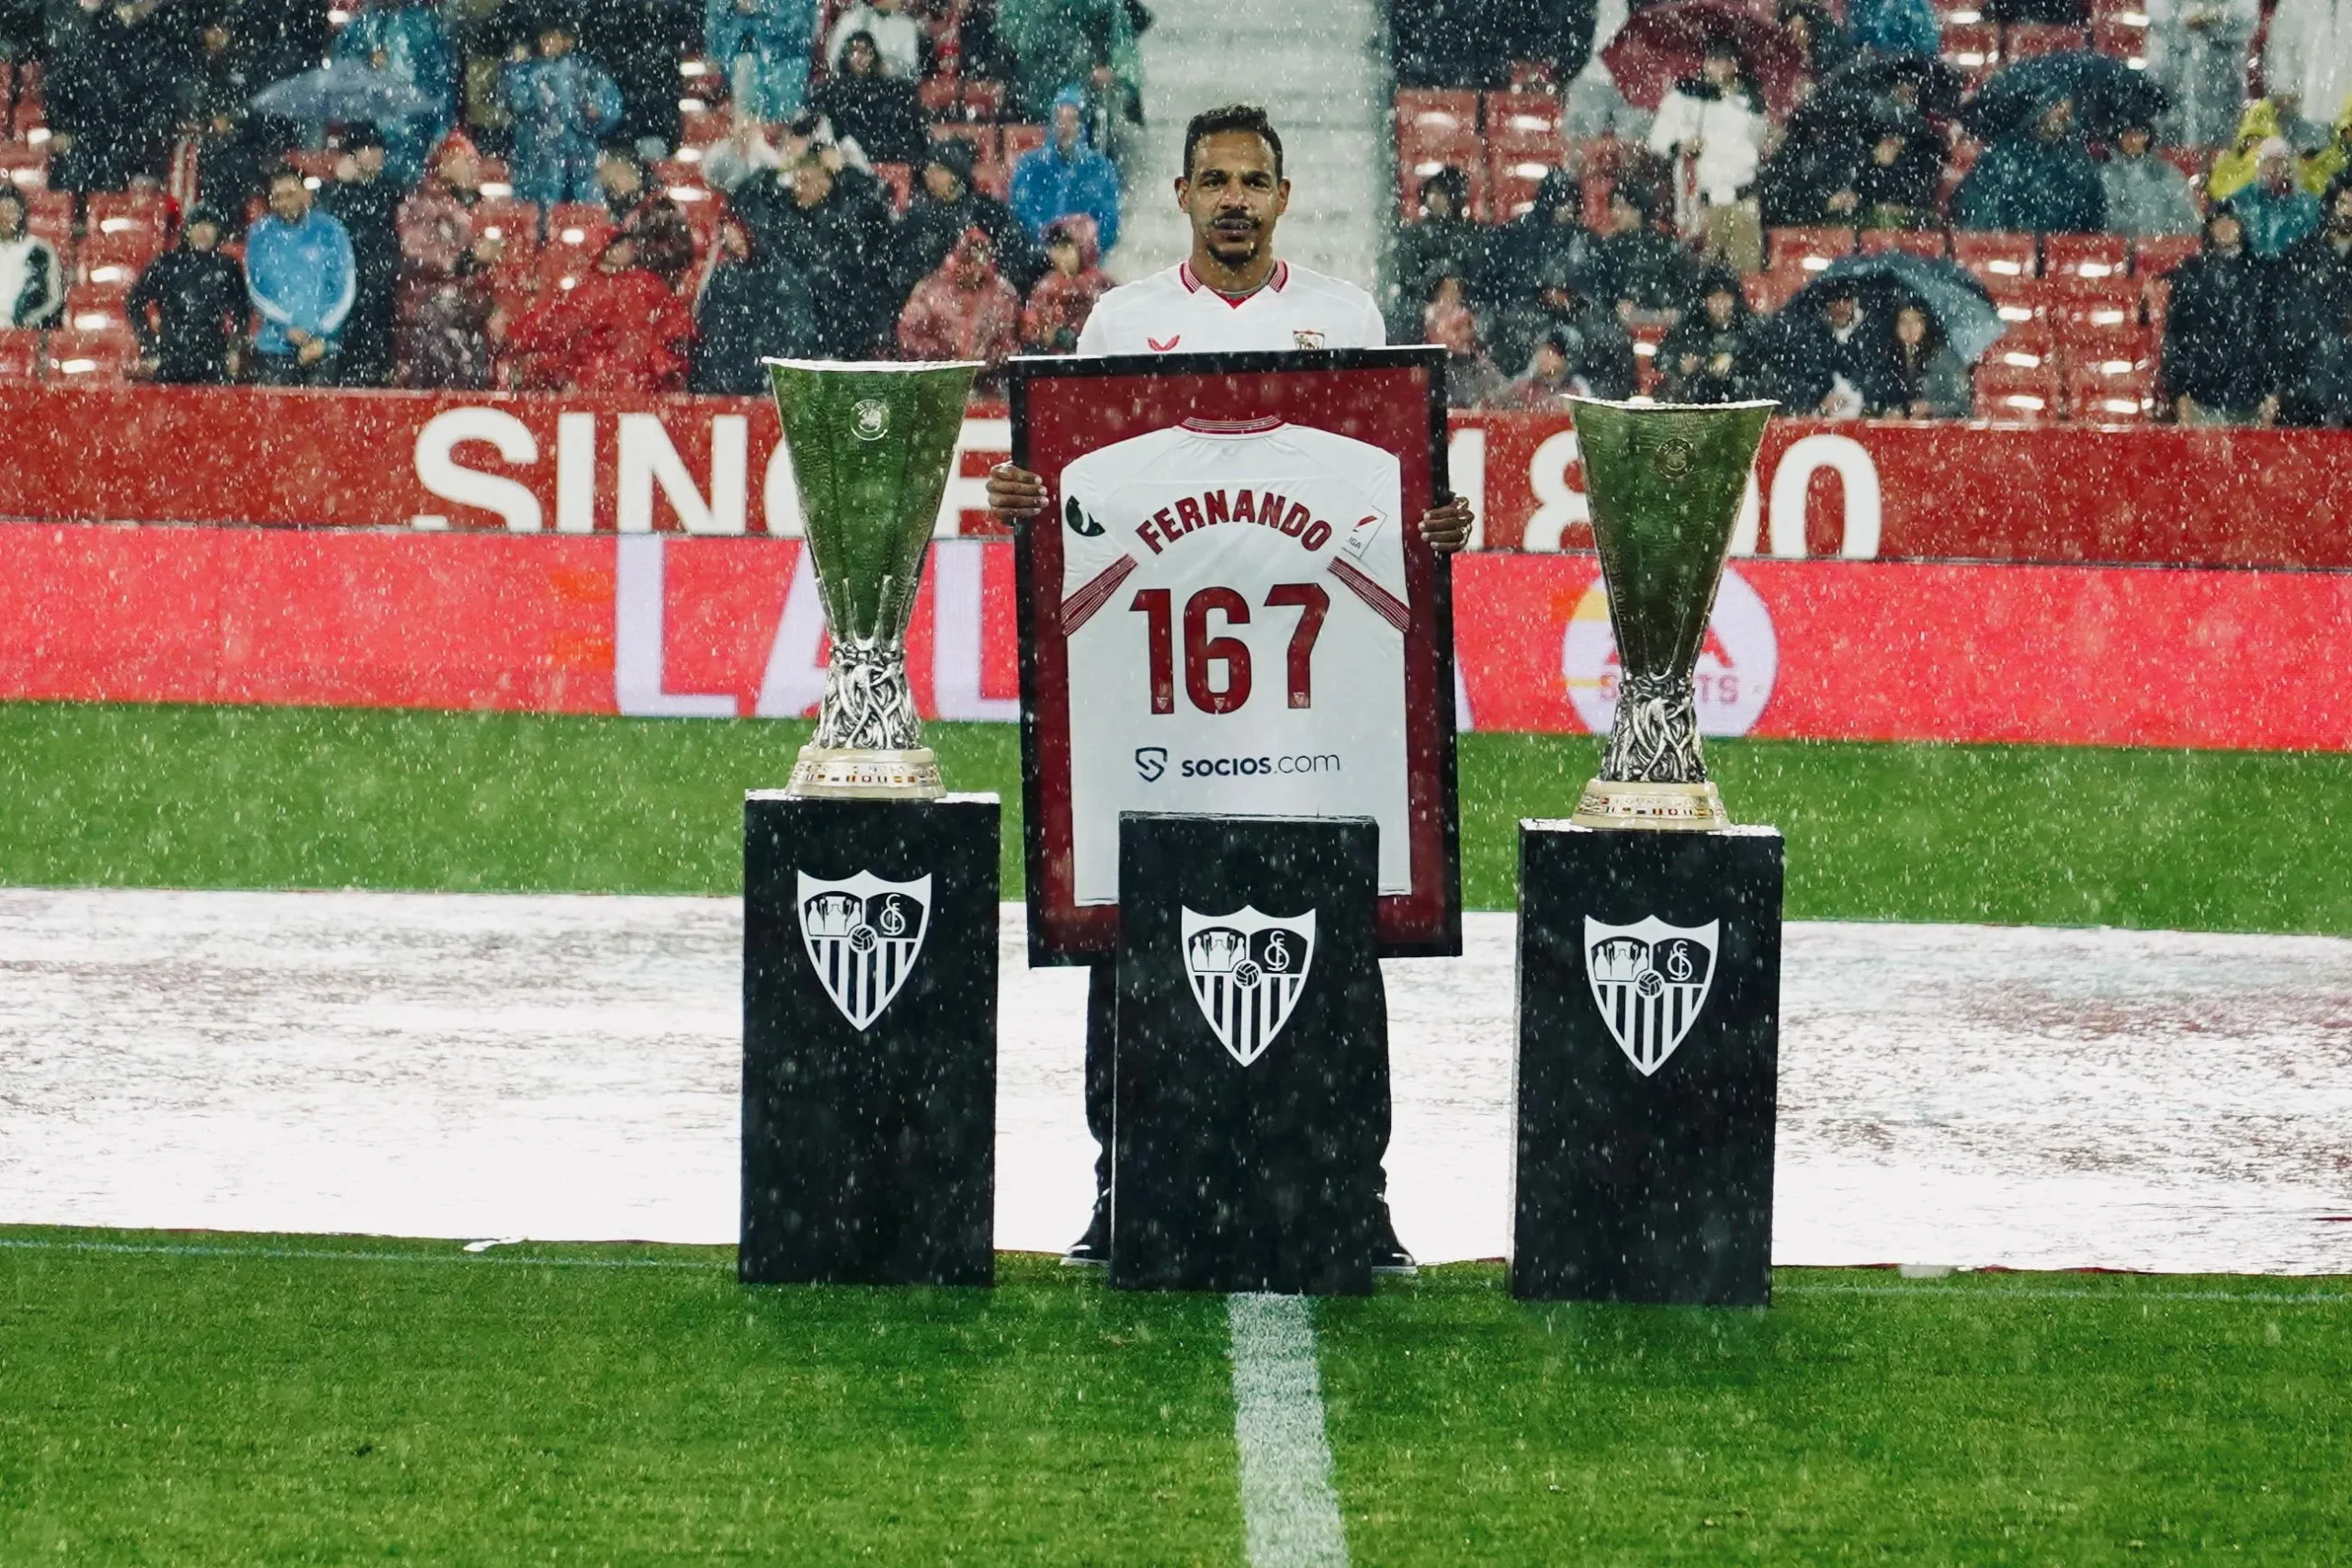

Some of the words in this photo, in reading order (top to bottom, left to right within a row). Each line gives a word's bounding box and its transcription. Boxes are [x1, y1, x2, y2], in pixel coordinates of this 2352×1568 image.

[413, 407, 1012, 537] SINE
[1448, 428, 1882, 558] 180
[1135, 489, 1332, 555] FERNANDO
[1129, 582, 1330, 715] 167
